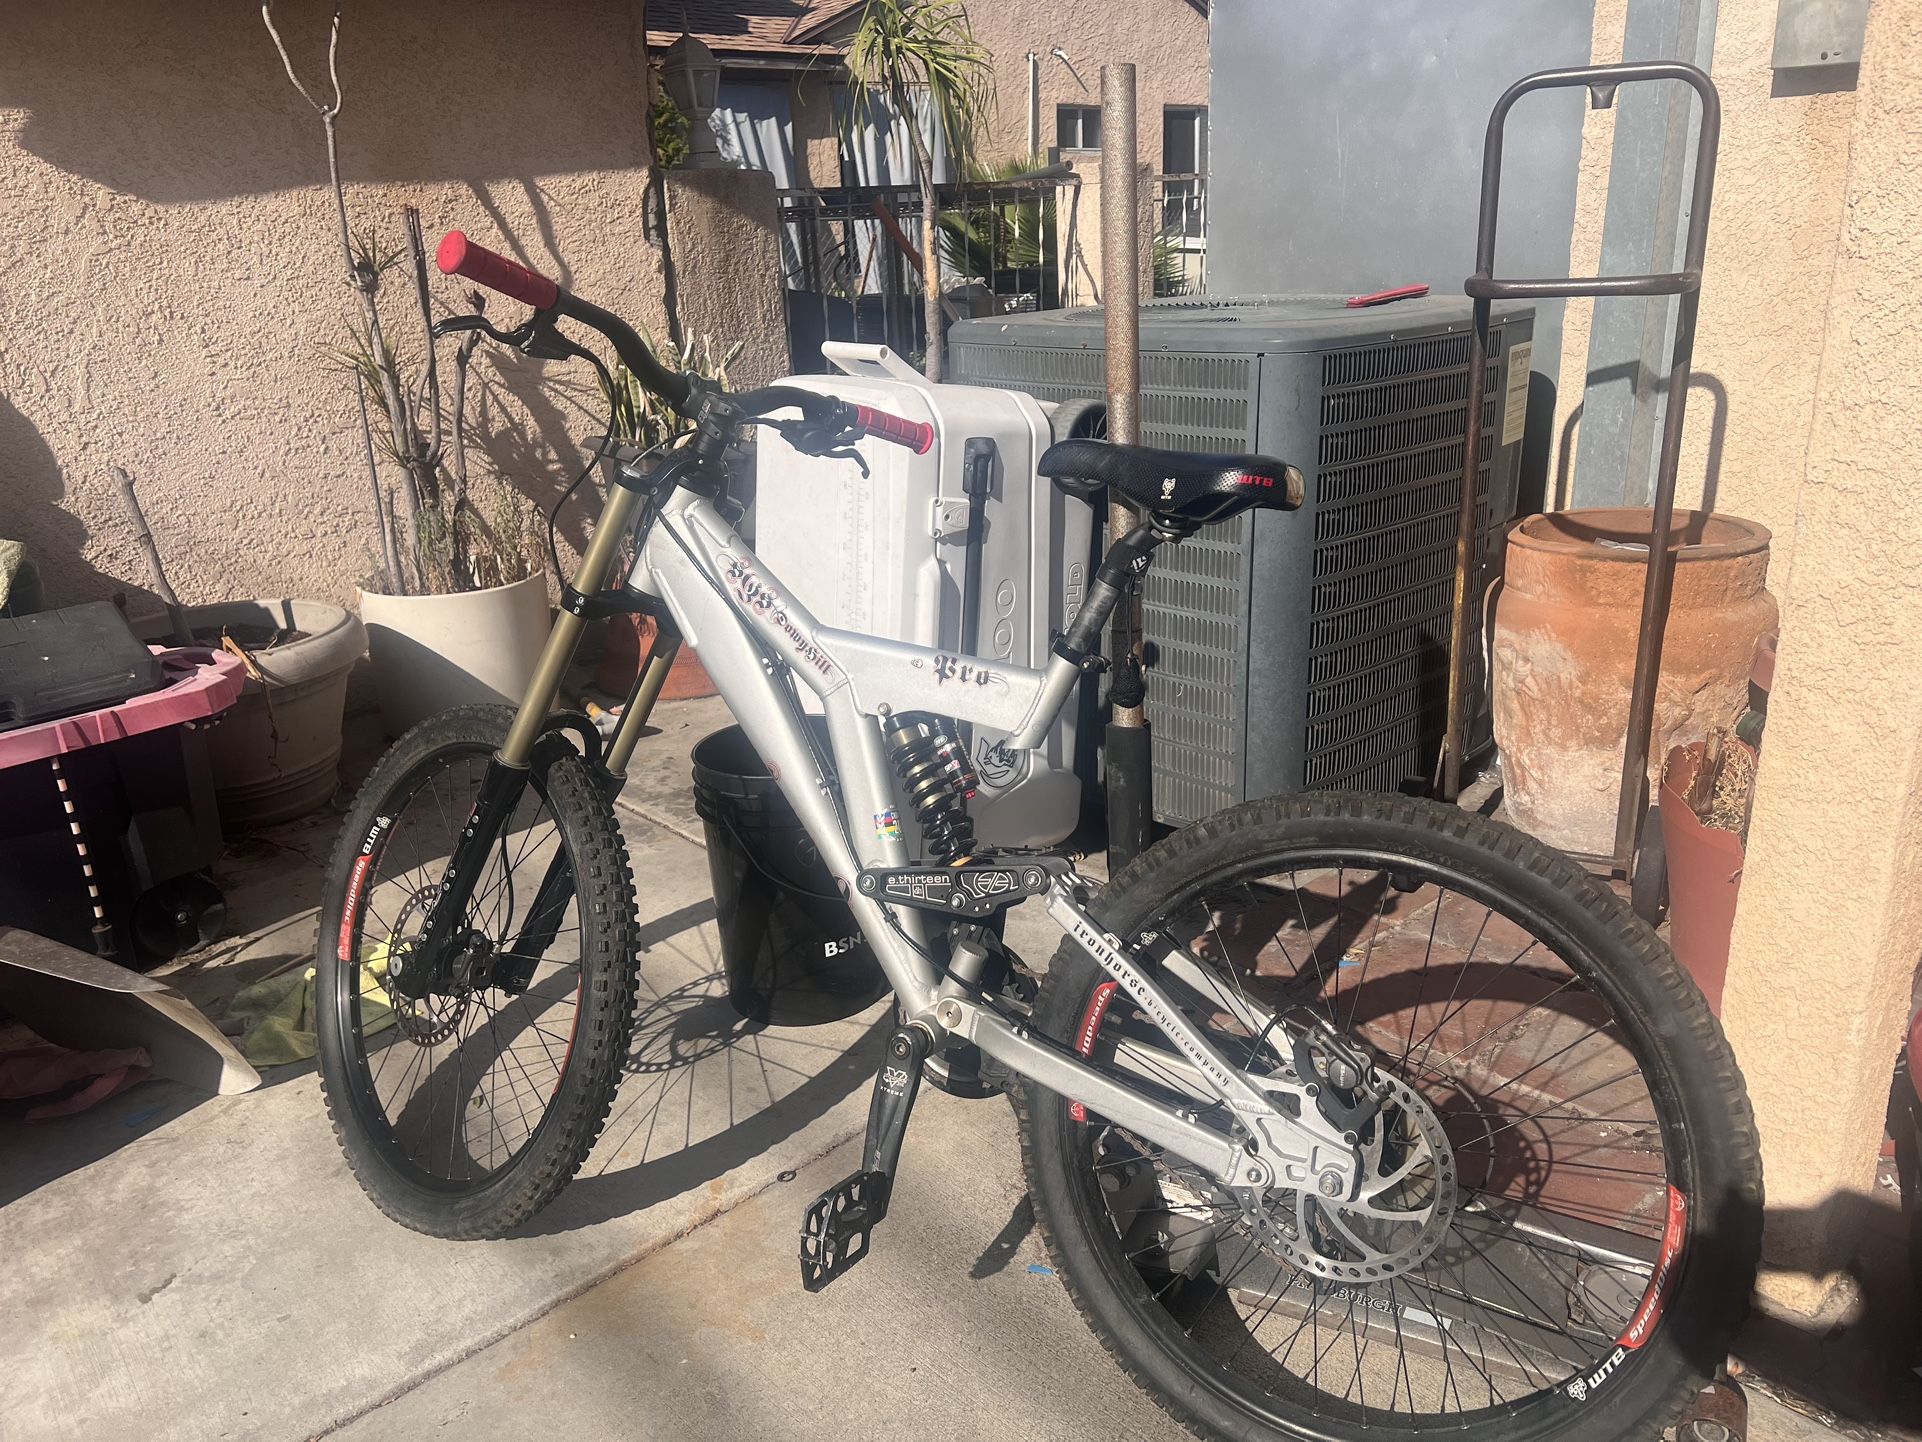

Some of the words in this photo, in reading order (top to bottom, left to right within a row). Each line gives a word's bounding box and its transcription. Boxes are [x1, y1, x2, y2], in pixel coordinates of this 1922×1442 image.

[1237, 473, 1275, 487] WTB
[934, 654, 990, 687] Pro
[362, 825, 380, 855] WTB
[888, 874, 950, 884] e.thirteen
[1081, 986, 1112, 1057] SpeedDi
[1628, 1247, 1674, 1342] SpeedDisc
[1588, 1347, 1627, 1389] WTB
